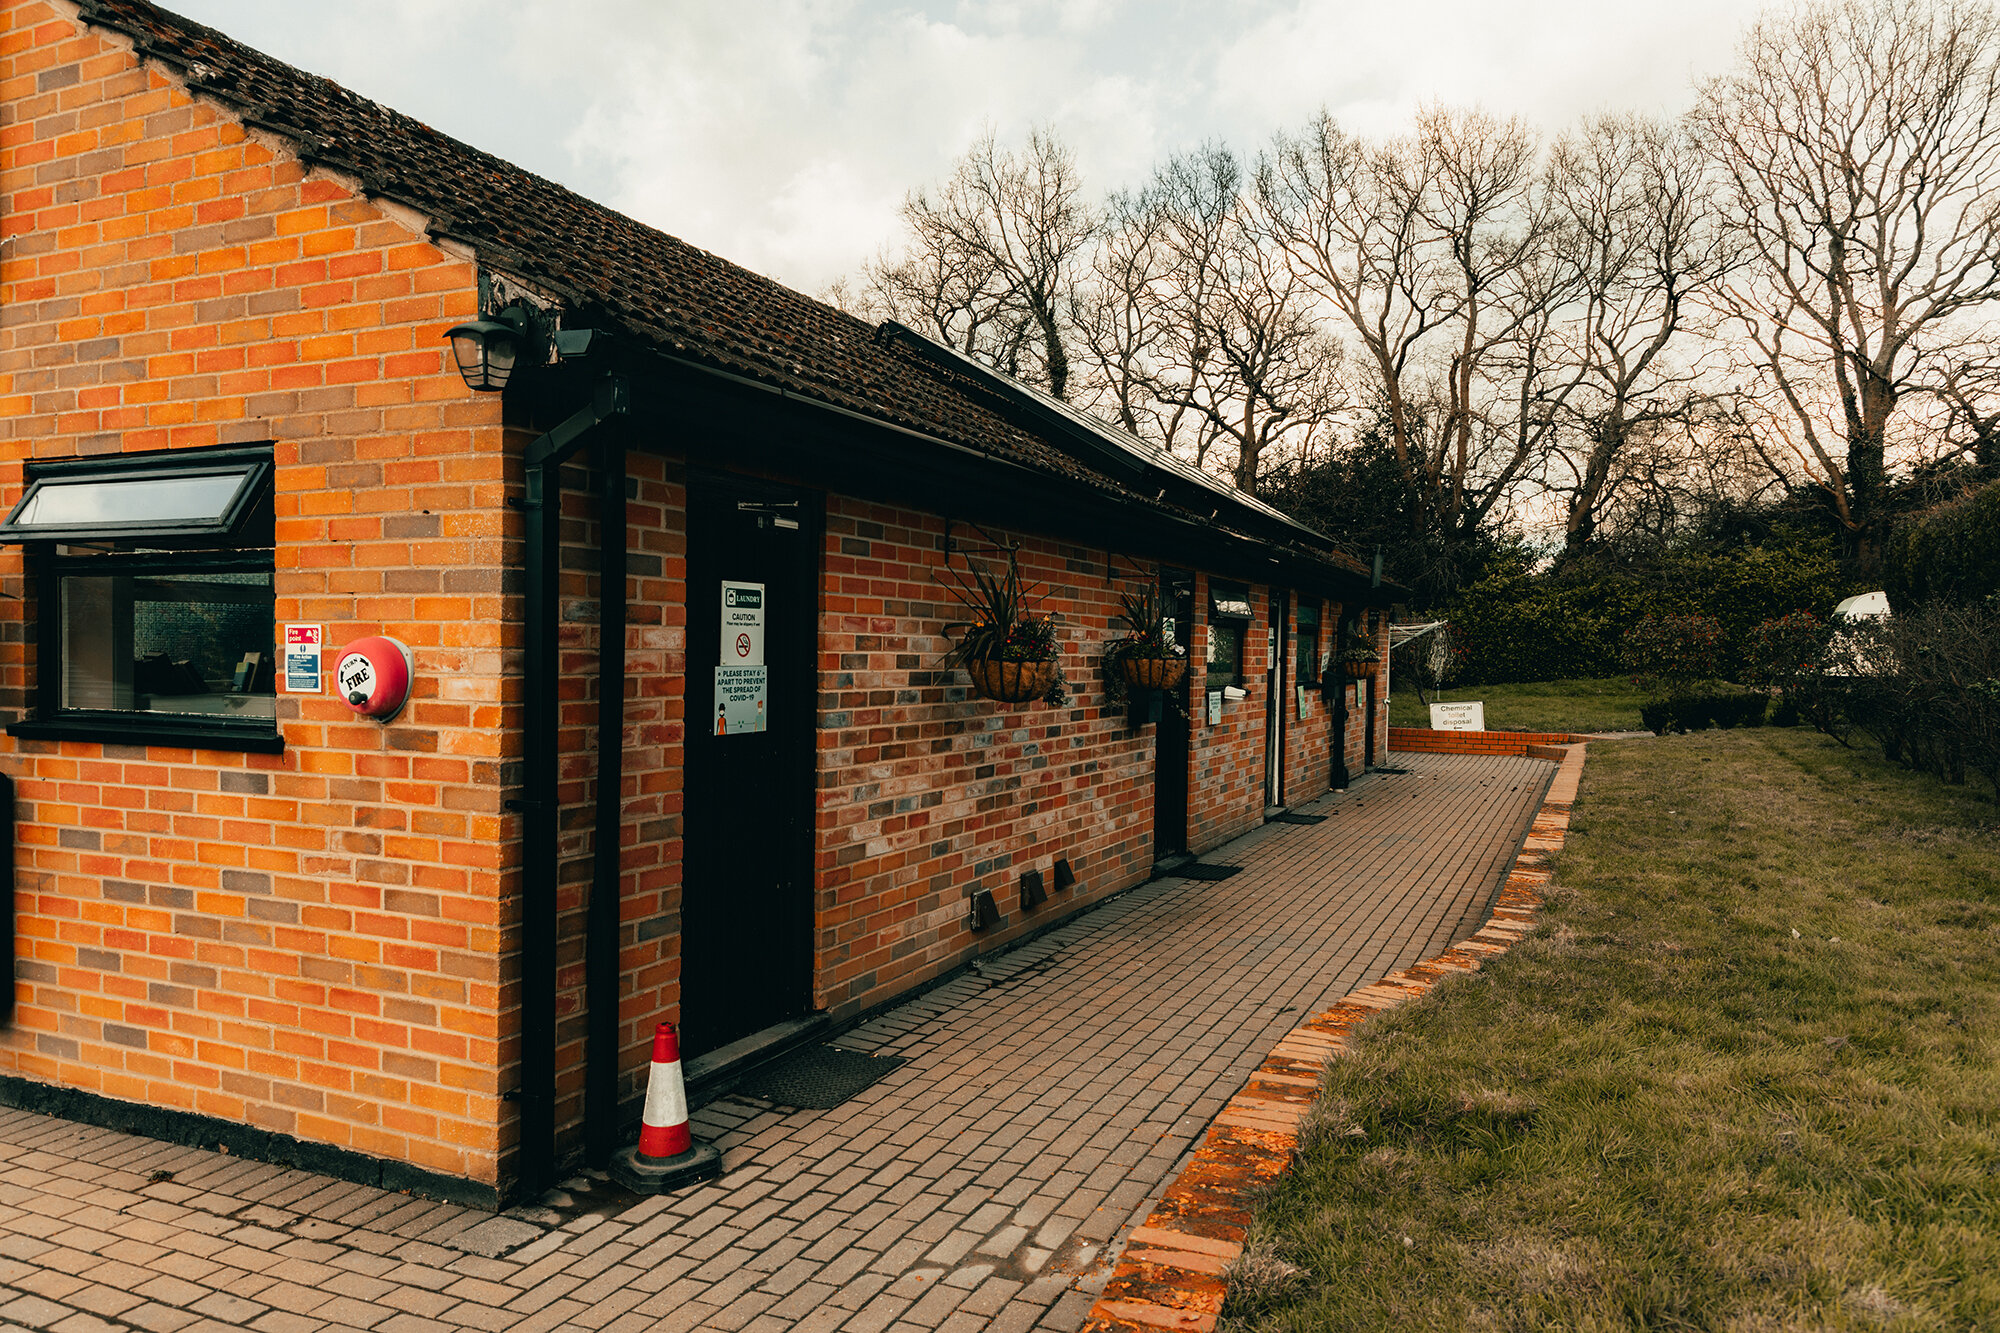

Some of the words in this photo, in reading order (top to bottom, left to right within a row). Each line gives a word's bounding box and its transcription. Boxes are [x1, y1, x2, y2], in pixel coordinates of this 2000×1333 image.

[736, 595, 760, 603] LAUNDRY
[732, 613, 756, 621] CAUTION
[343, 657, 358, 670] TURN
[346, 668, 370, 691] FIRE
